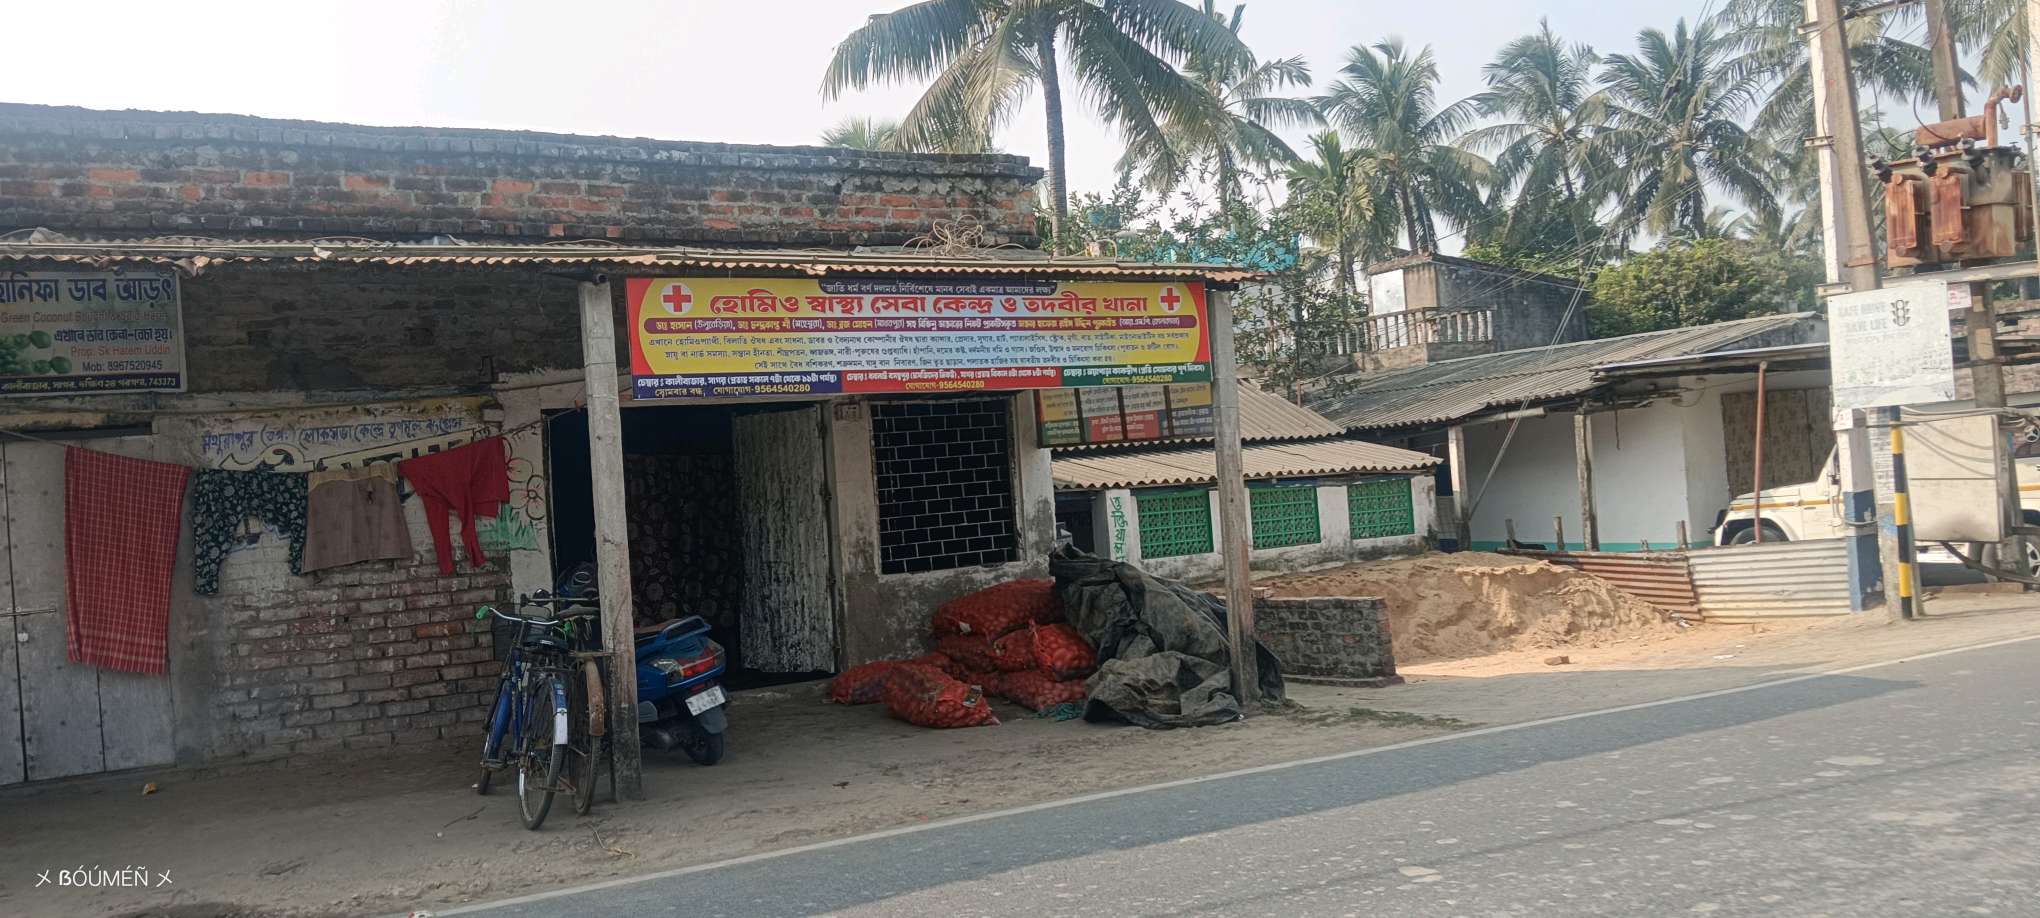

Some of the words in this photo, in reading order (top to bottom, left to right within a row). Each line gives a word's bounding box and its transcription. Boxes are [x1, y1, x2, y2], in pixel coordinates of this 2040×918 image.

[67, 279, 107, 303] ডাব
[848, 282, 860, 292] ধর্ম
[861, 282, 873, 292] বর্ণ
[710, 288, 800, 314] হোমিও
[805, 295, 864, 315] স্বাস্থ্য
[871, 295, 926, 314] সেবা
[933, 296, 993, 314] কেন্দ্র
[1000, 297, 1018, 312] ও
[1022, 290, 1098, 314] তদবীর
[1103, 297, 1148, 312] খানা
[0, 312, 31, 323] Green
[33, 311, 74, 322] Coconut
[649, 338, 673, 346] এখানে
